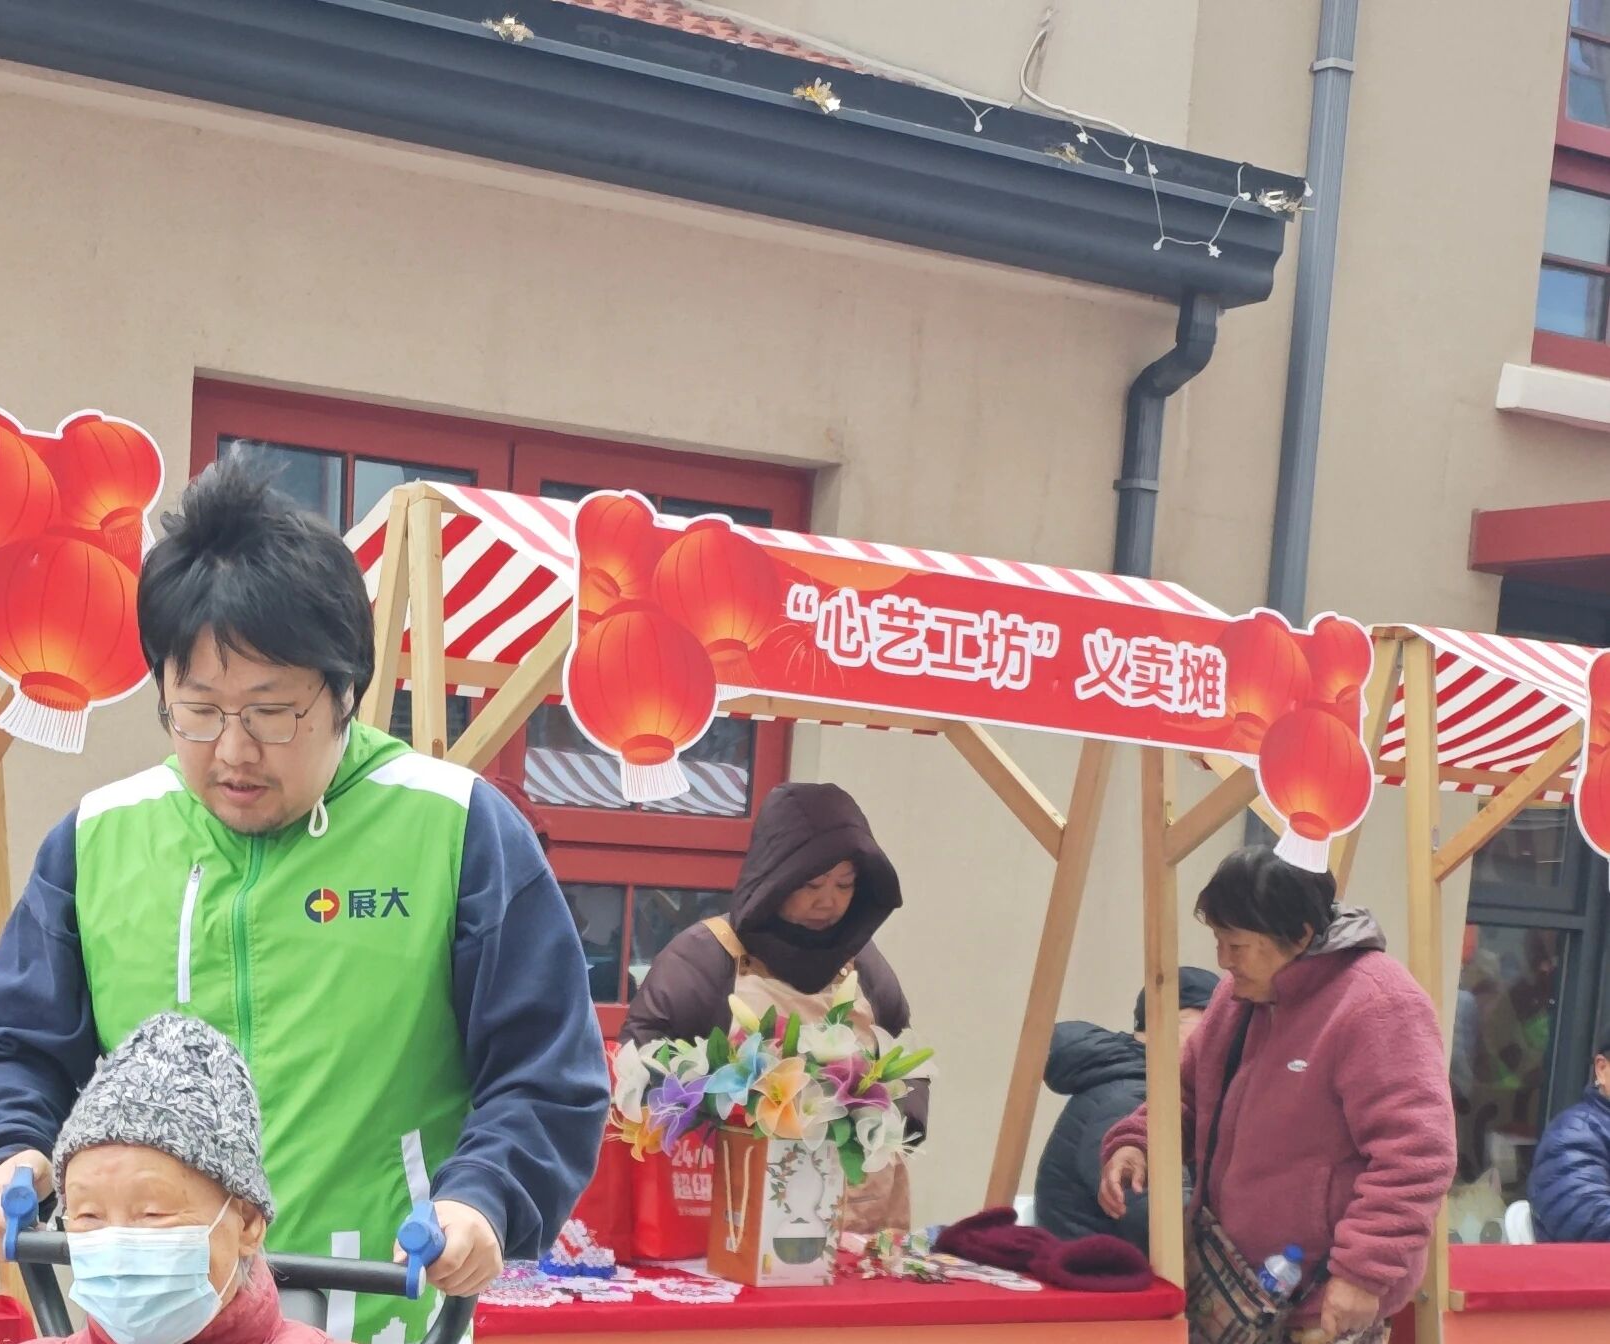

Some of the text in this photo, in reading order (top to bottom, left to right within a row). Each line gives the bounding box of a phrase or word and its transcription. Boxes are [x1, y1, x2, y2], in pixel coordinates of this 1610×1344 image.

[1079, 632, 1224, 713] 义卖摊
[348, 887, 410, 920] 展大
